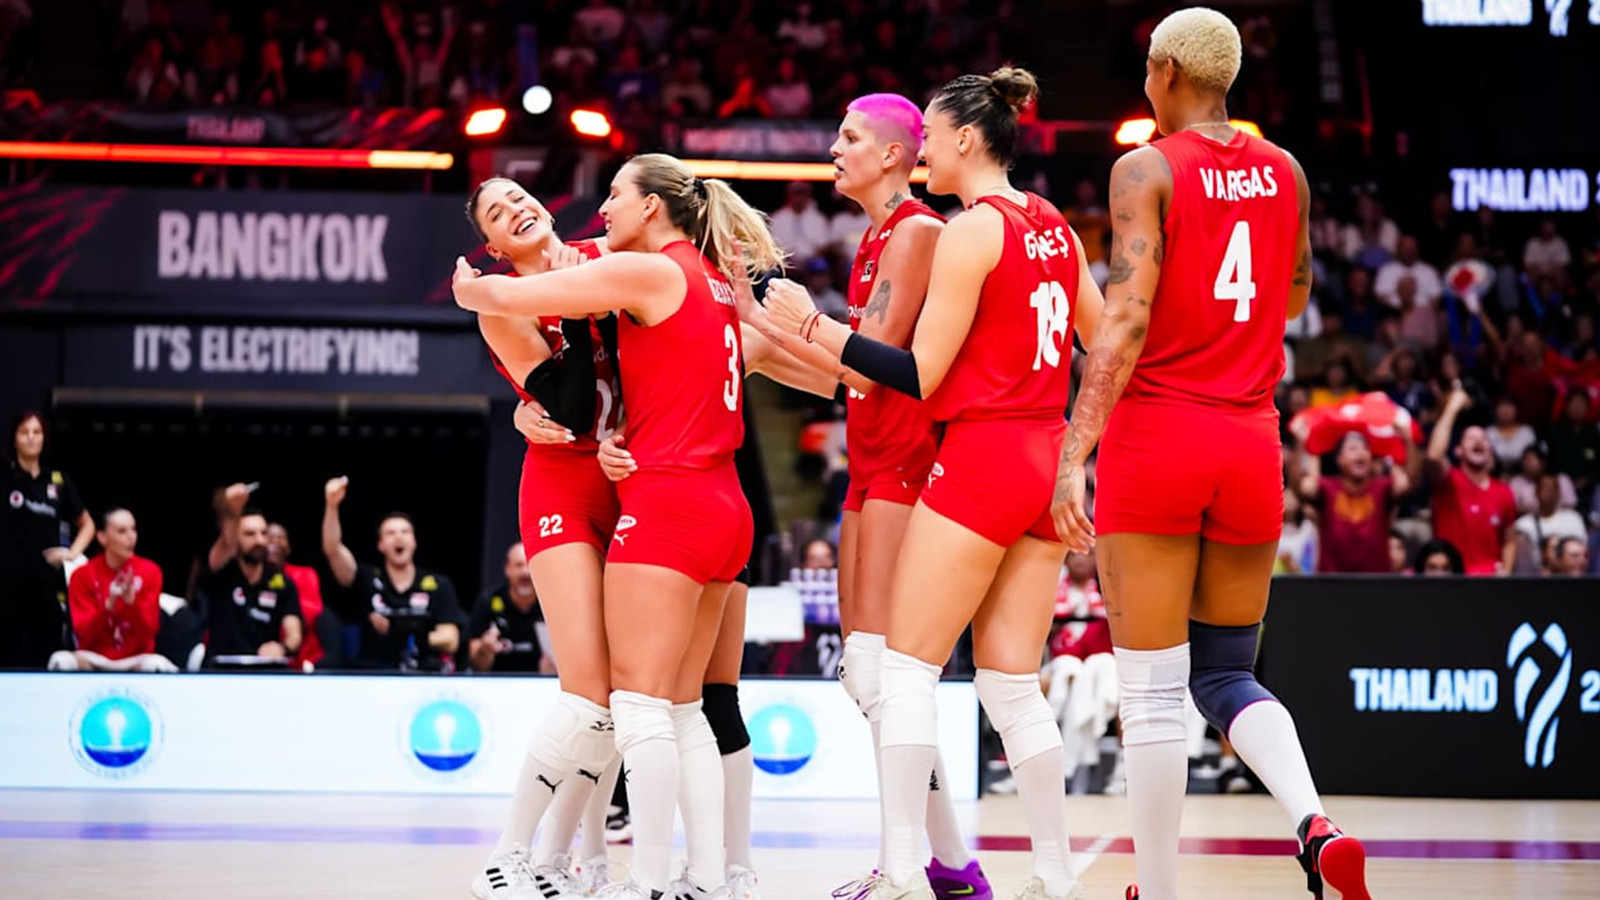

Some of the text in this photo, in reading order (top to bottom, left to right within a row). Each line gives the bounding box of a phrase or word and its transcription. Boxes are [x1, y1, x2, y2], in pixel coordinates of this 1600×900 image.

[1199, 165, 1278, 201] VARGAS
[1450, 168, 1589, 211] THAILAND
[158, 210, 388, 282] BANGKOK
[1213, 221, 1256, 322] 4
[134, 325, 419, 376] IT'S ELECTRIFYING!
[1029, 281, 1070, 371] 18
[723, 323, 740, 411] 3
[538, 513, 564, 538] 22
[1349, 668, 1499, 712] THAILAND
